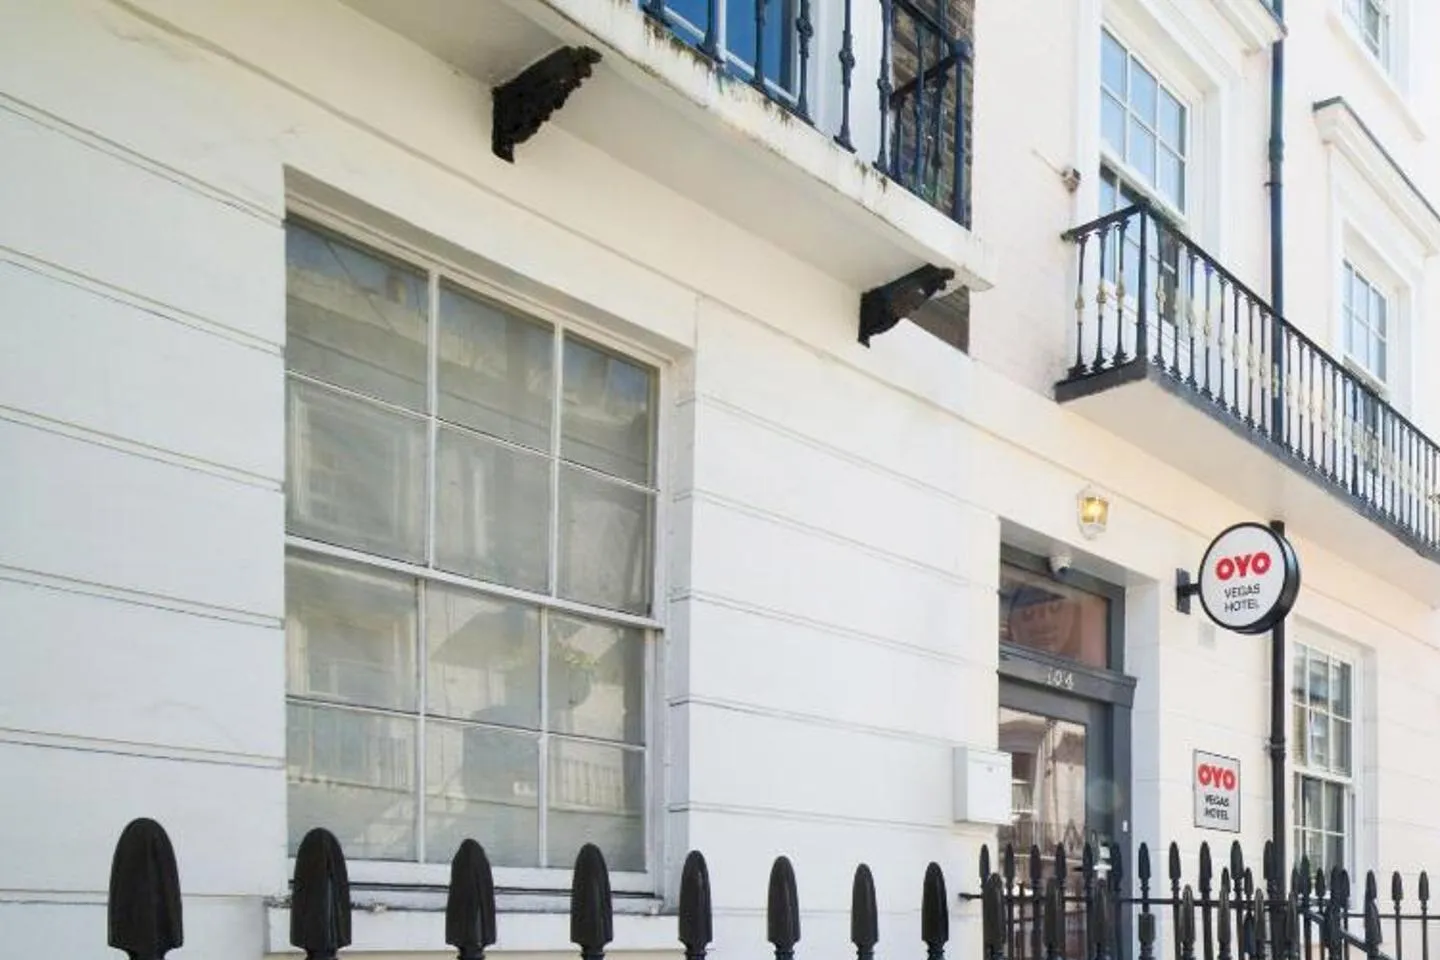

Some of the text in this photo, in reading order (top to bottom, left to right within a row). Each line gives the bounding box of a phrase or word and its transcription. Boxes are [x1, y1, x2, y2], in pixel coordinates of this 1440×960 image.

[1215, 551, 1272, 581] OYO
[1224, 583, 1261, 599] VEGAS
[1224, 599, 1260, 613] HOTEL
[1046, 666, 1075, 691] 104
[1197, 763, 1236, 790] OYO
[1204, 794, 1230, 807] VEGAS
[1204, 807, 1230, 821] HOTEL
